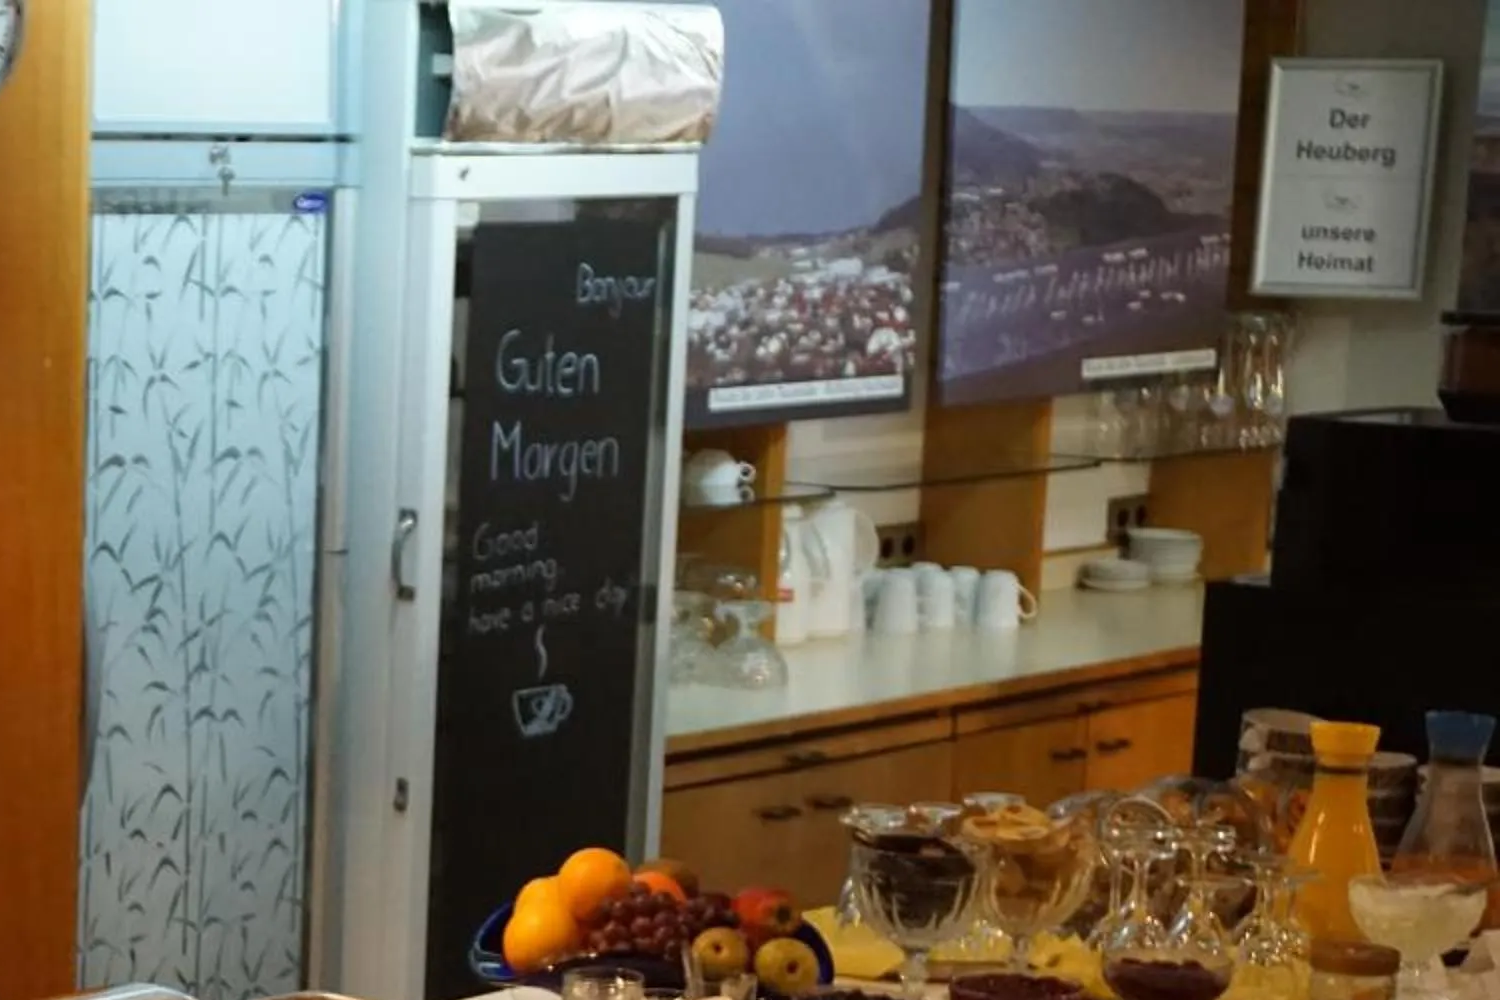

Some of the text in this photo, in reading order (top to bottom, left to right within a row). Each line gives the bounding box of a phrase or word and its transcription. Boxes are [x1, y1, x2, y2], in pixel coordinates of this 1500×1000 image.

[1328, 107, 1370, 129] Der
[1295, 140, 1397, 167] Heuberg
[1300, 224, 1376, 242] unsere
[1297, 250, 1375, 273] Heimat
[496, 328, 600, 394] Guten
[490, 419, 620, 502] Morgen
